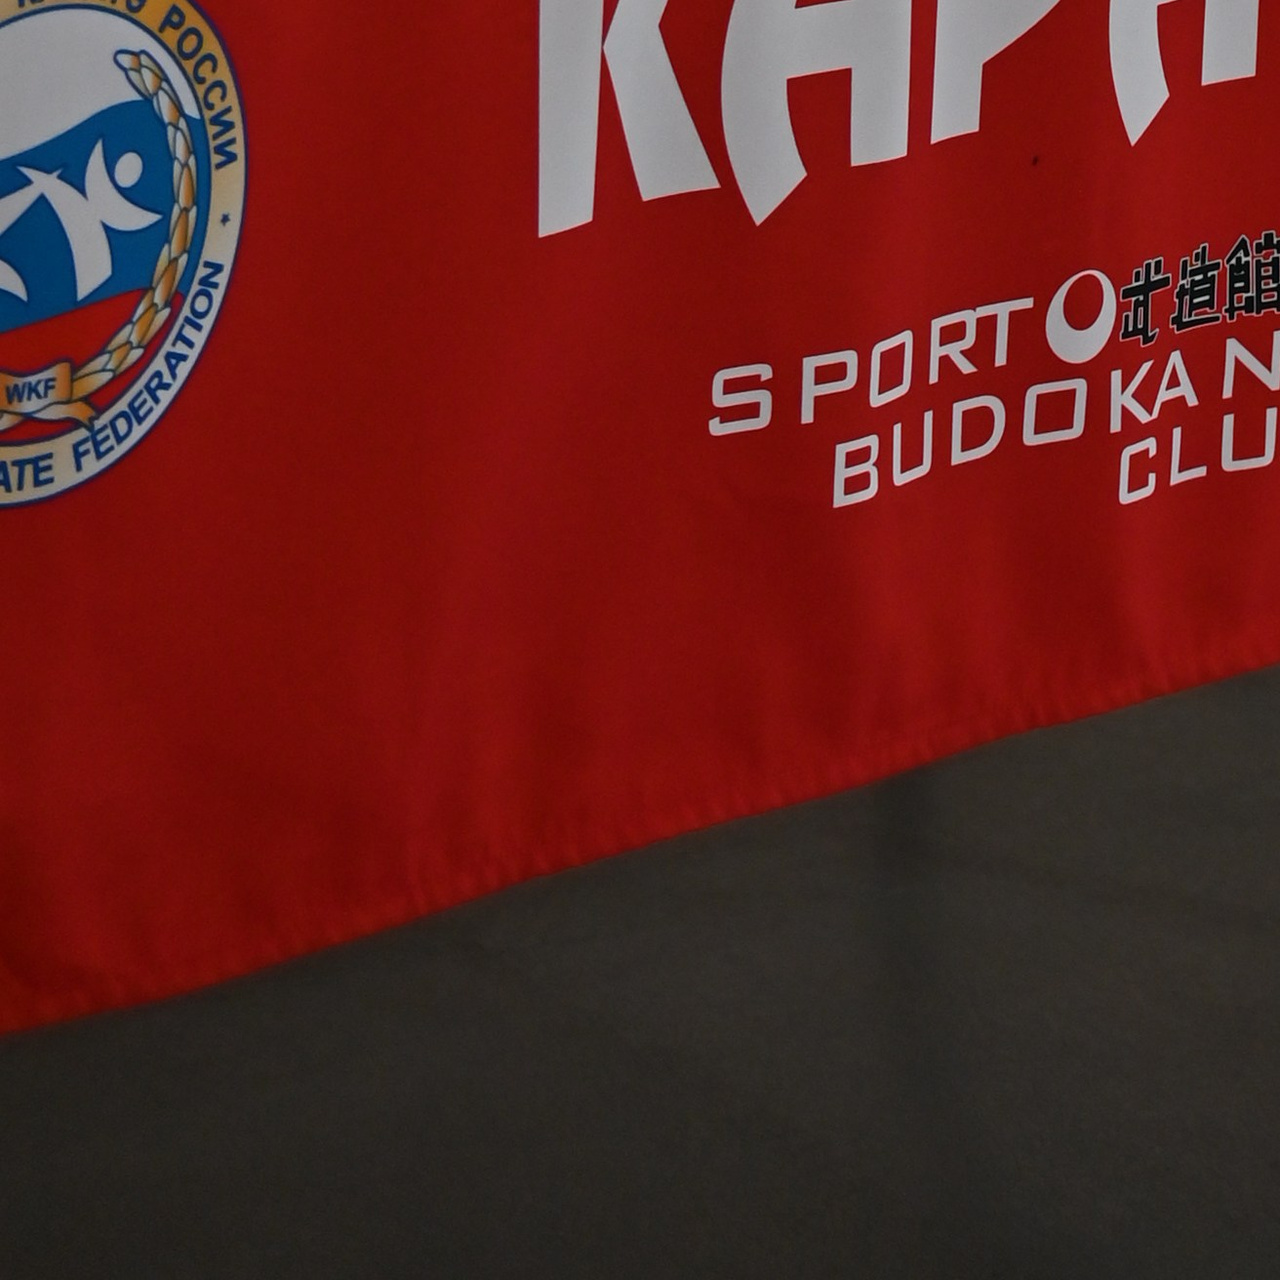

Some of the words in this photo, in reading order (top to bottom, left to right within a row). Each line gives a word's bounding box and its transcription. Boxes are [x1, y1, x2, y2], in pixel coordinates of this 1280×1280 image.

[158, 4, 238, 170] РОССИИ
[5, 377, 56, 404] WKF
[72, 260, 224, 472] FEDERATION
[708, 297, 1034, 436] SPORT
